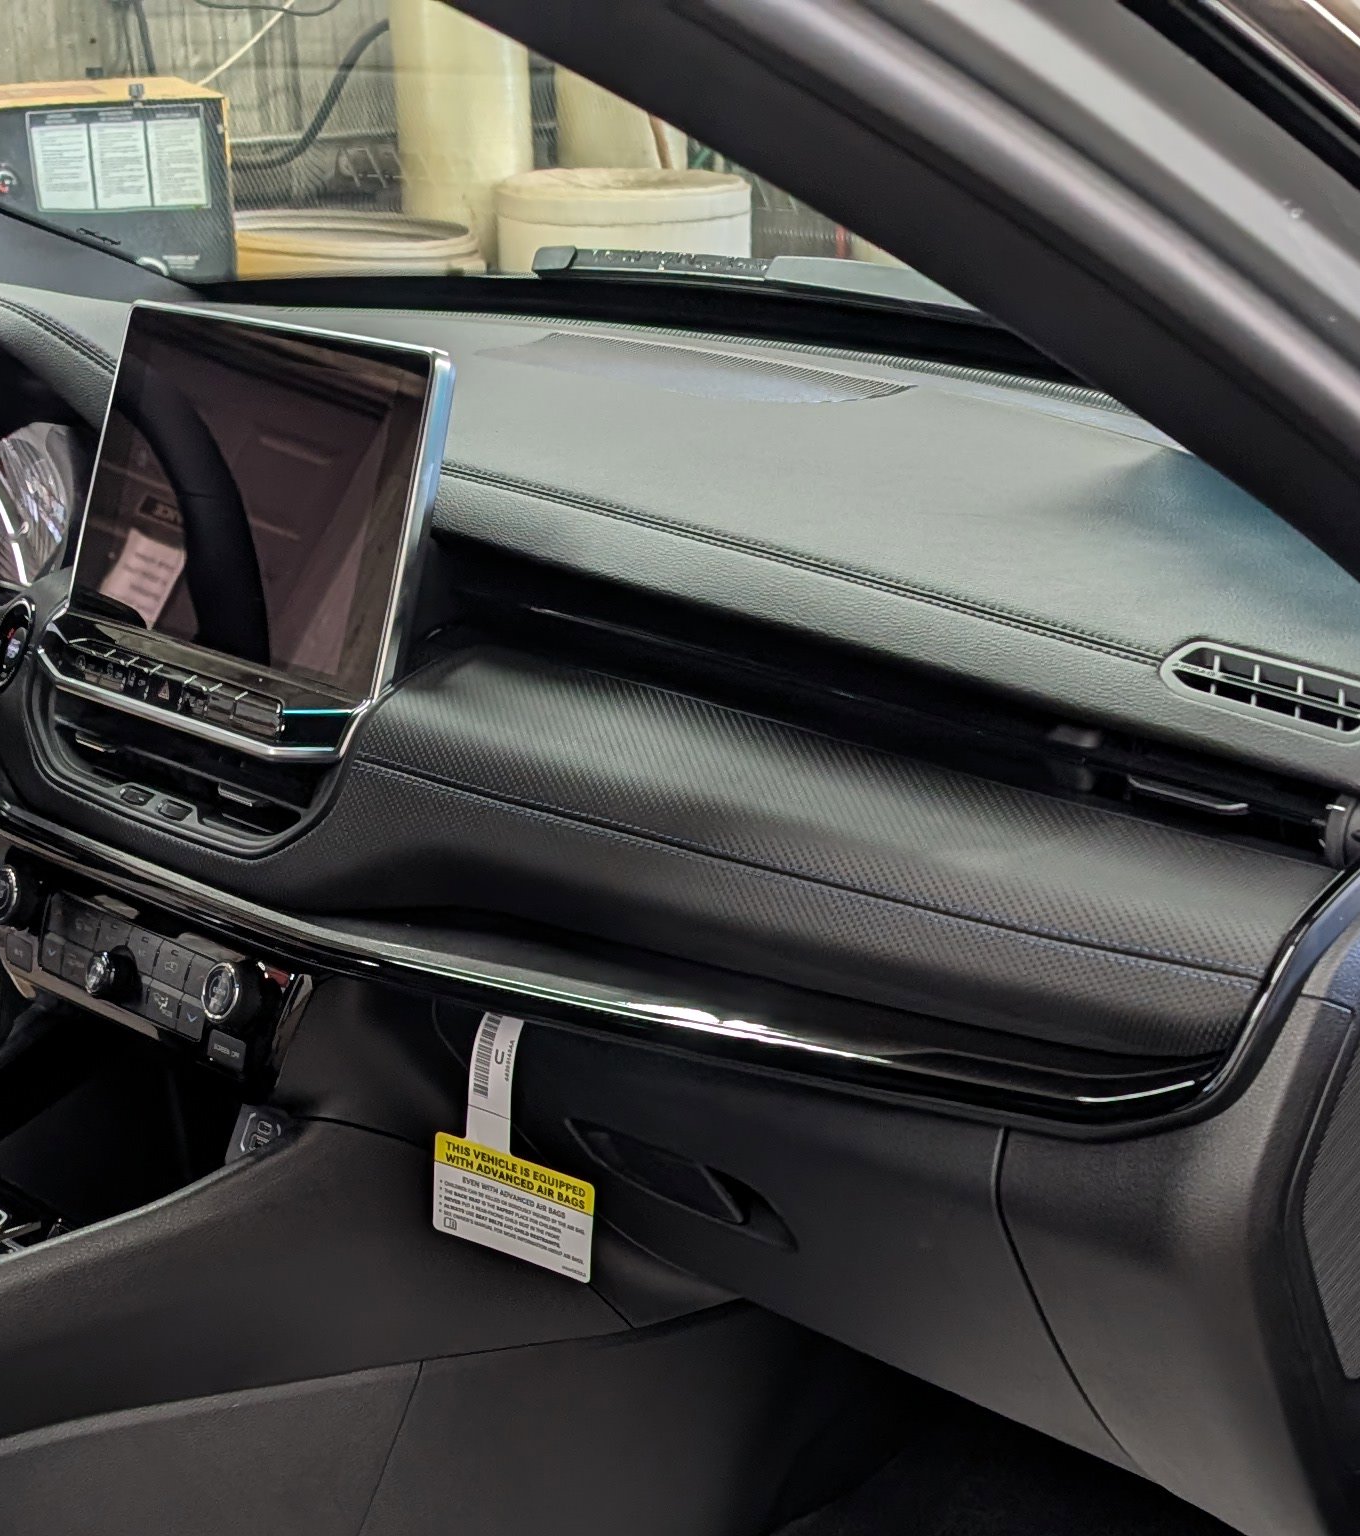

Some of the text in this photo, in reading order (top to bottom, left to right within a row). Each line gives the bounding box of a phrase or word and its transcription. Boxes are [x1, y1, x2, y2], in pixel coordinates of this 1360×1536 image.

[445, 1141, 586, 1198] THIS VEHICLE IS EQUIPPED
[445, 1153, 474, 1170] WITH
[476, 1163, 535, 1191] ADVANCED
[536, 1185, 555, 1199] AIR
[557, 1192, 586, 1211] BAGS
